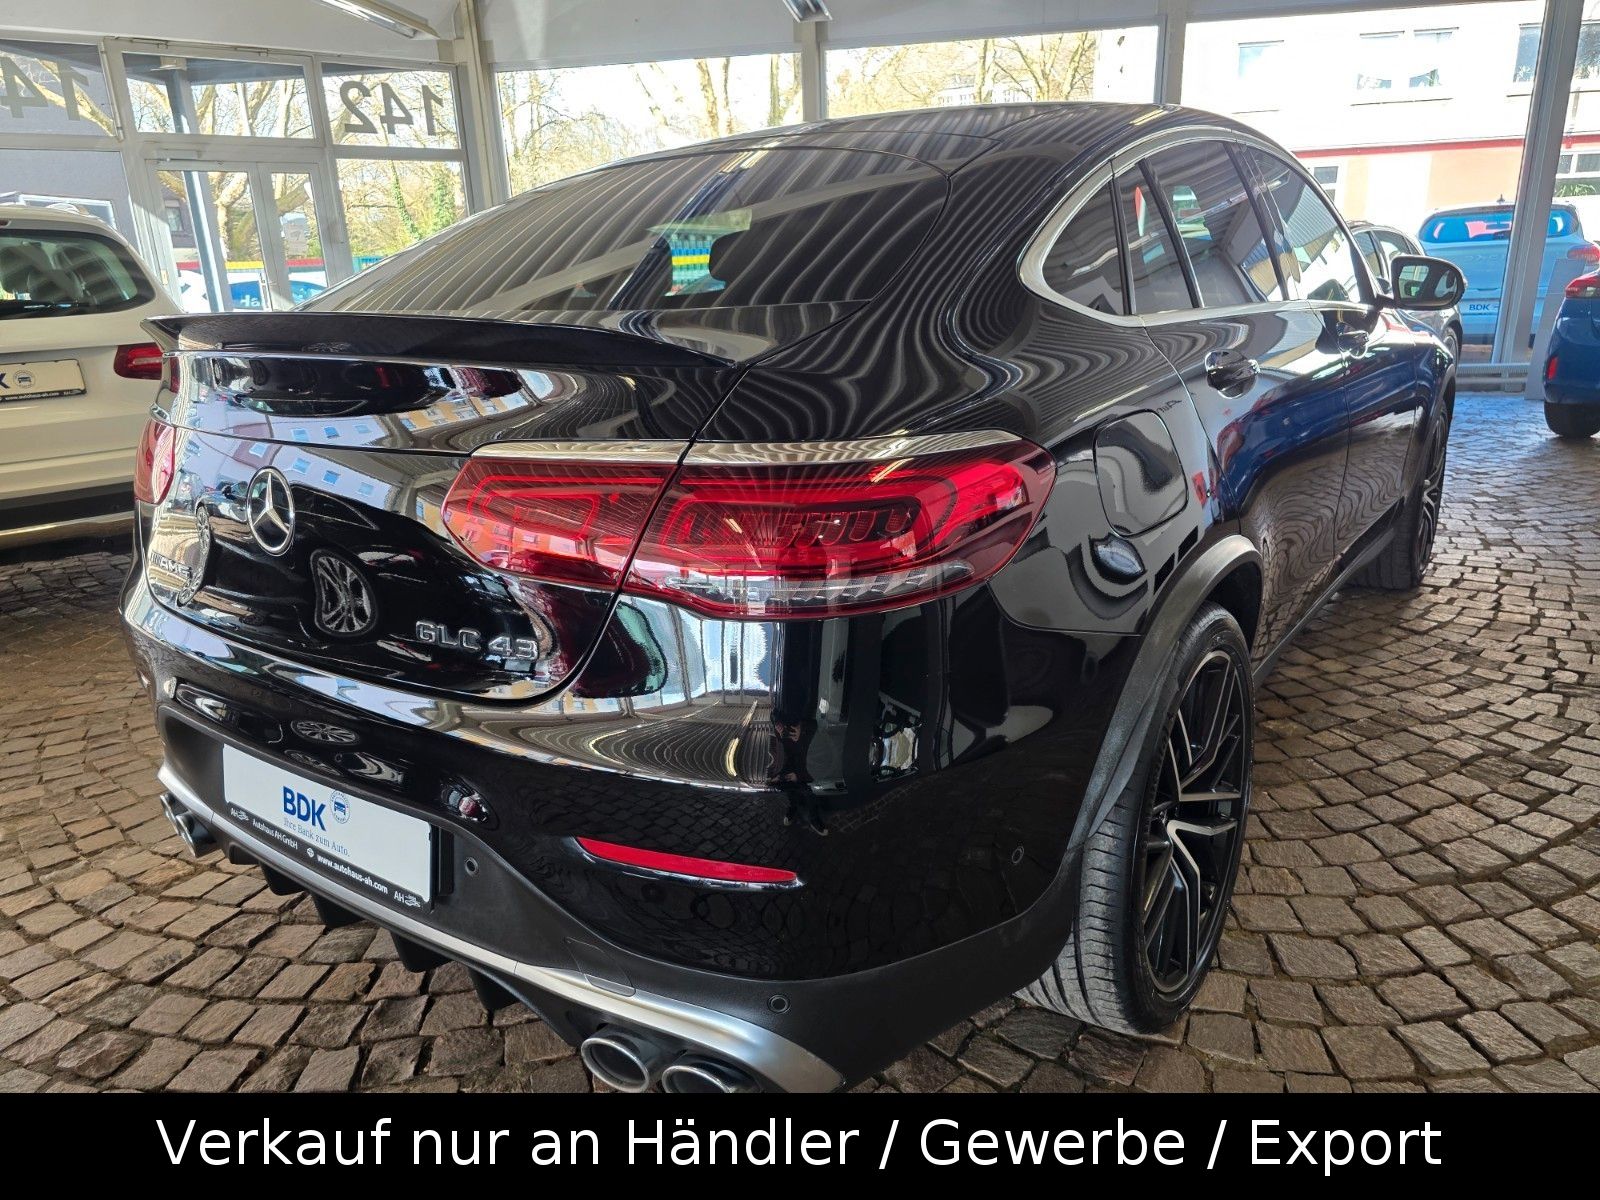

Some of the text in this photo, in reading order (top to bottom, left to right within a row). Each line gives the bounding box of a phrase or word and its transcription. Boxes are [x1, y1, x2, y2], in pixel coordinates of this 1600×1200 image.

[1468, 303, 1490, 311] BDK
[416, 621, 538, 661] GLC 43
[283, 785, 326, 832] BDK
[252, 818, 298, 850] Autohaus AH GmbH
[283, 817, 350, 857] Ihre Bank zum Auto.
[316, 854, 389, 895] www.autohaus-ah.com
[393, 890, 405, 904] AH
